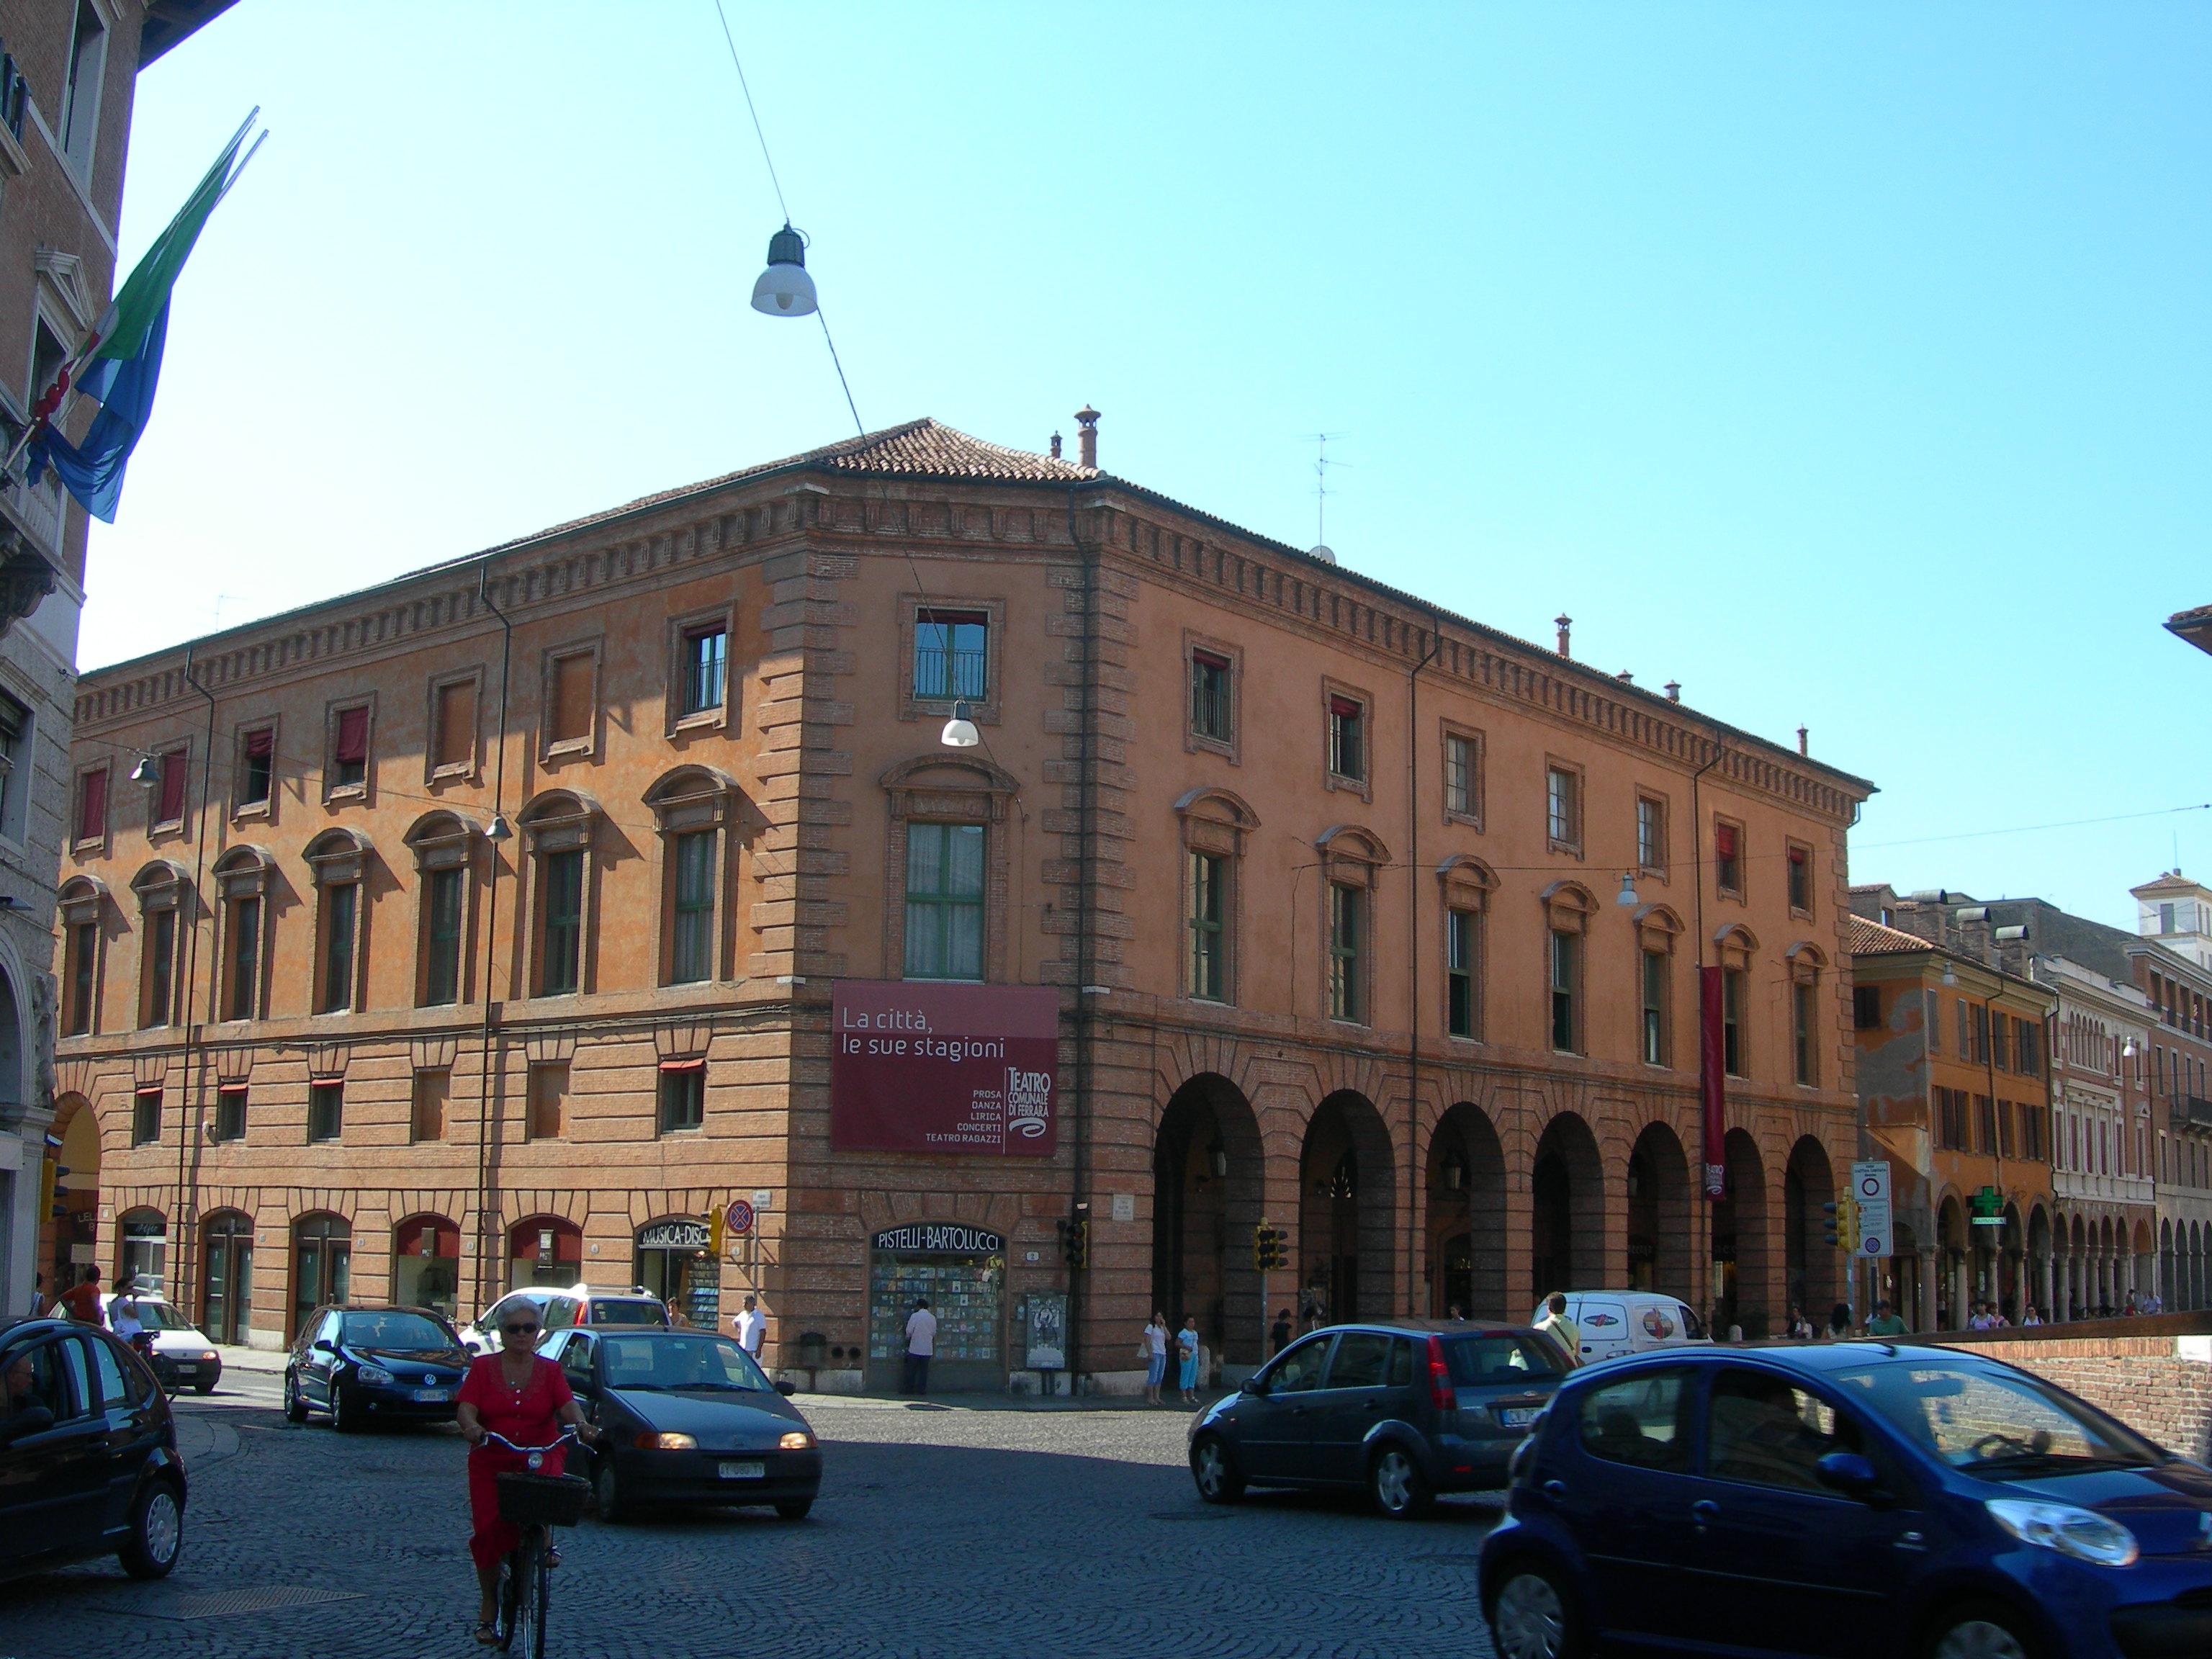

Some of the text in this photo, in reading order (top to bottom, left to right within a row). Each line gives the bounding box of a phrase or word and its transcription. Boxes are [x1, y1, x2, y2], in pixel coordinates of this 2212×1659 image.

[842, 1007, 933, 1034] La città,
[842, 1033, 1004, 1062] le sue stagioni
[1007, 1066, 1051, 1094] TEATRO
[973, 1089, 1002, 1100] PROSA
[1007, 1092, 1048, 1105] COMUNALE
[971, 1101, 1002, 1110] DANZA
[1008, 1105, 1049, 1118] DI FERRARA
[970, 1112, 1002, 1122] LIRICA
[956, 1123, 1001, 1133] CONCERTI
[926, 1133, 1001, 1144] TEATRO RAGAZZI
[643, 1225, 711, 1245] MUSICA-DISC
[878, 1226, 999, 1251] PISTELLI-BARTOLUCCI
